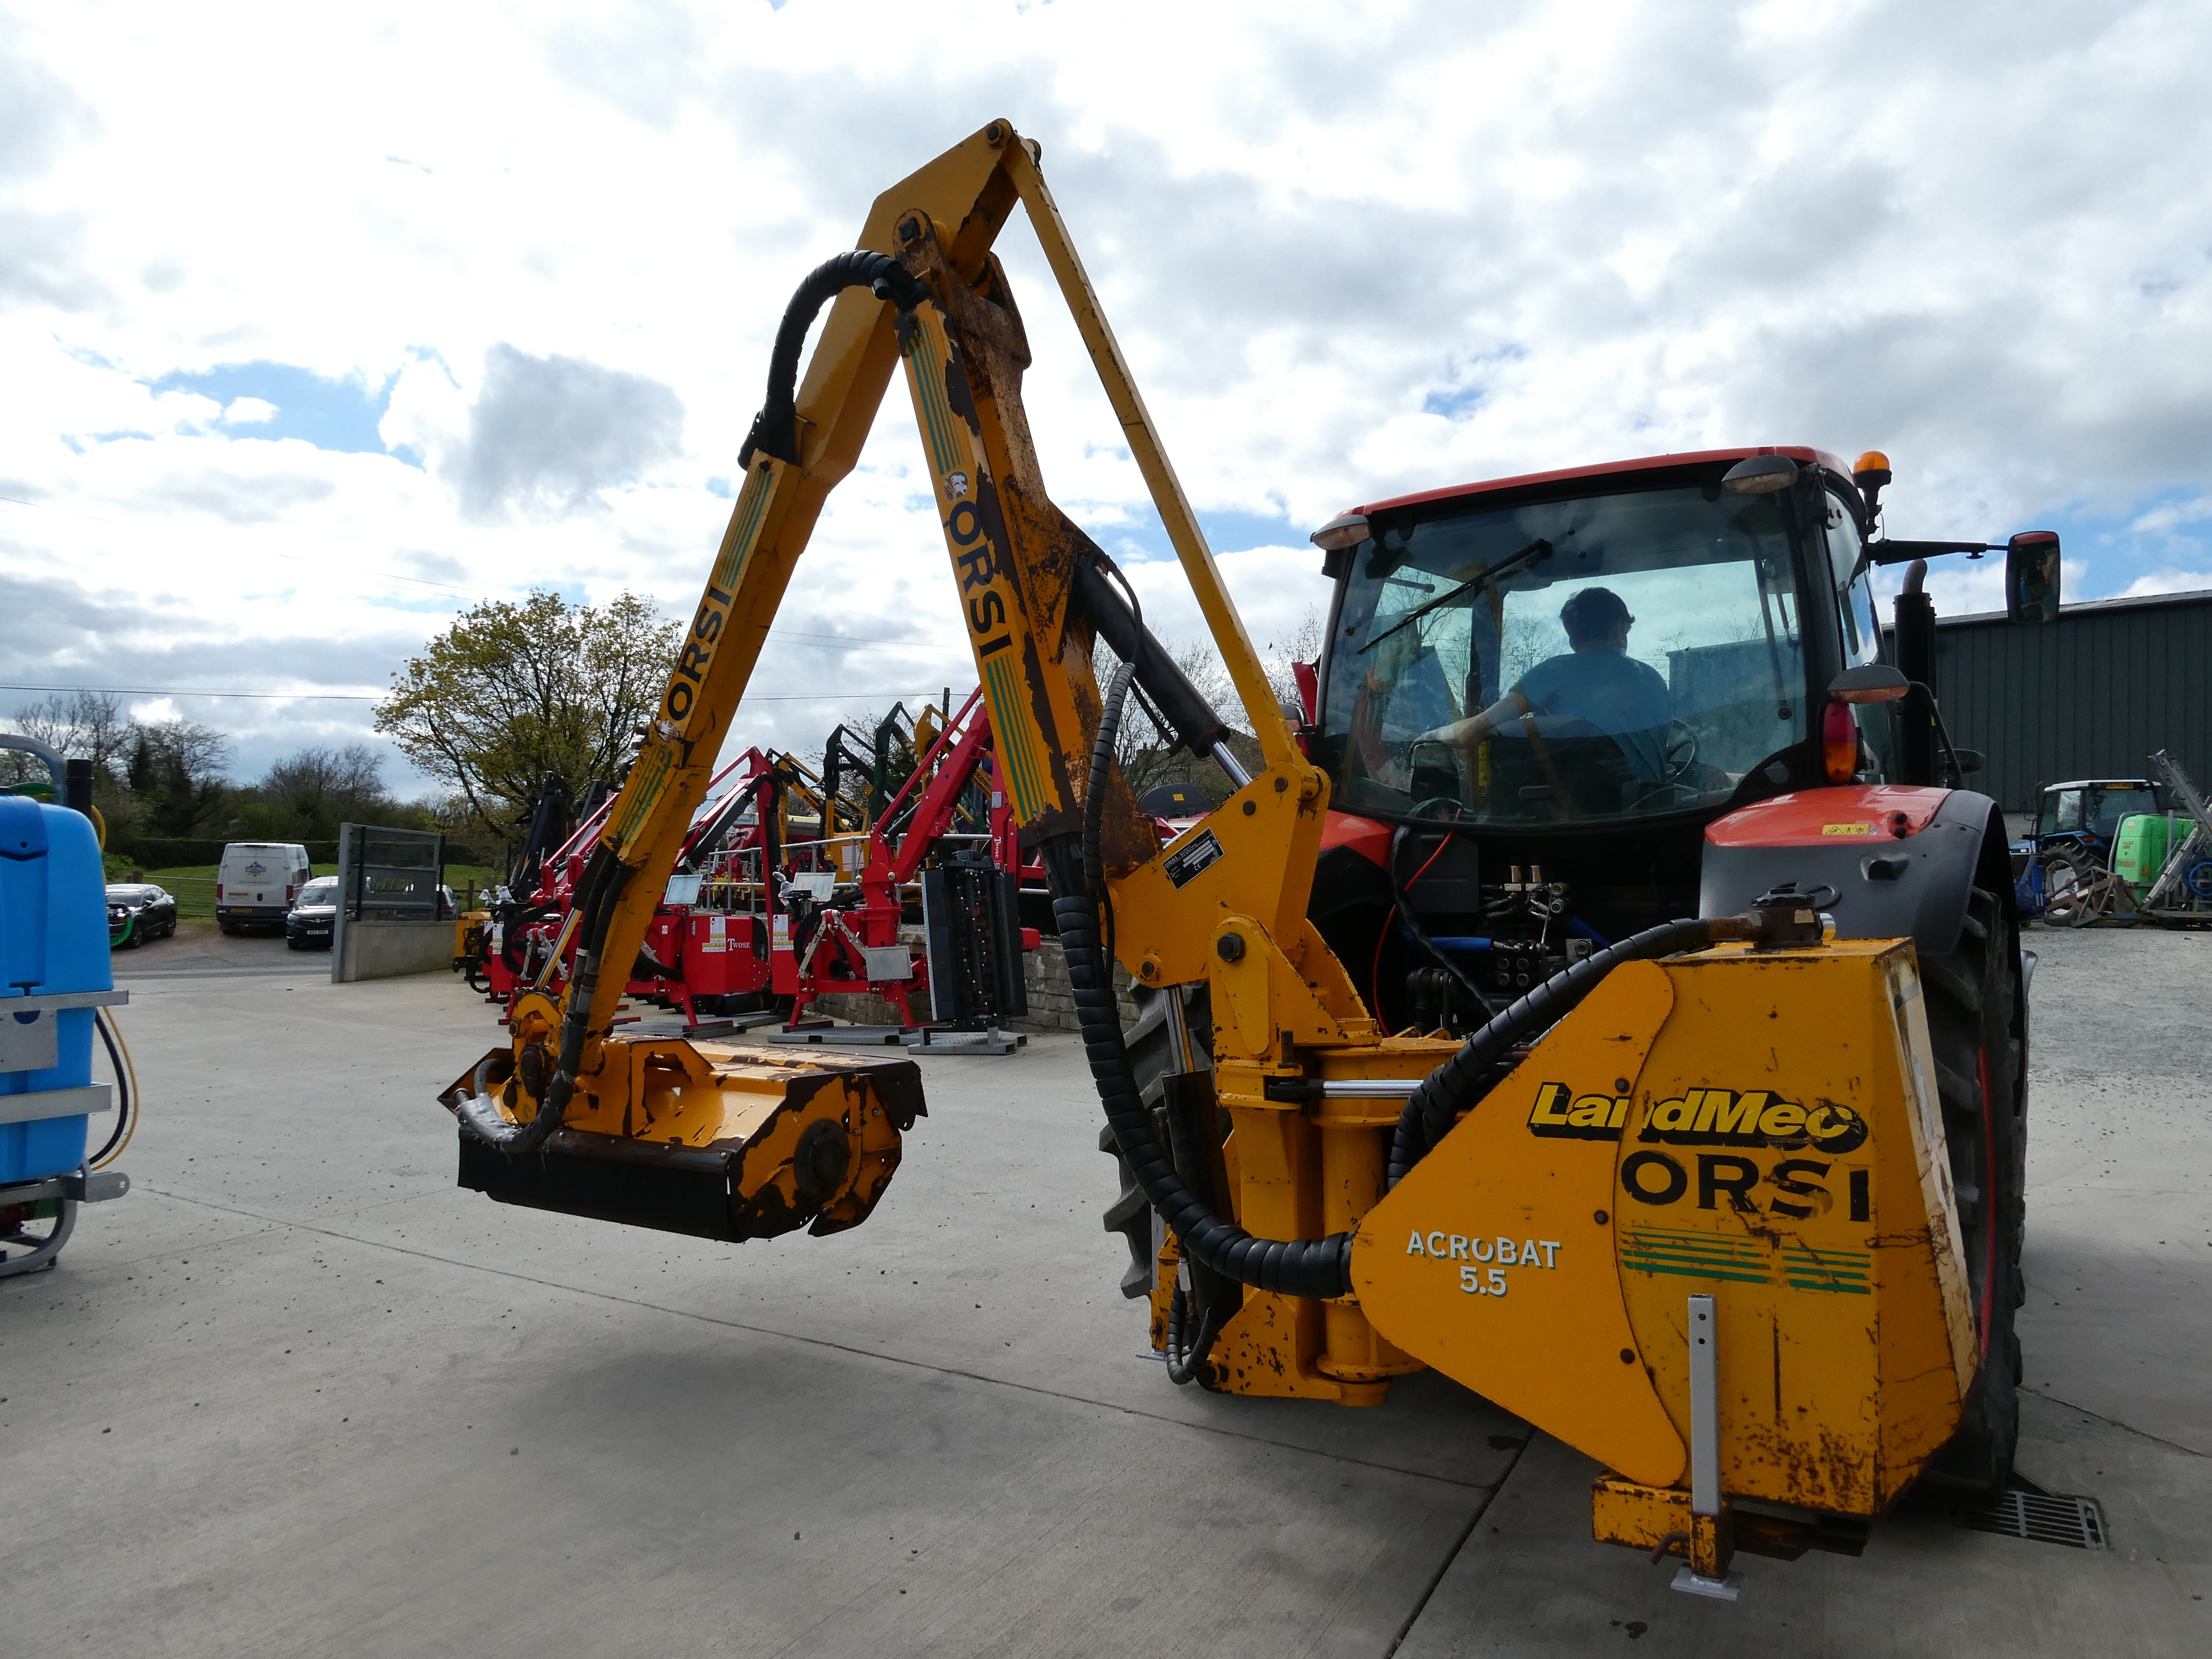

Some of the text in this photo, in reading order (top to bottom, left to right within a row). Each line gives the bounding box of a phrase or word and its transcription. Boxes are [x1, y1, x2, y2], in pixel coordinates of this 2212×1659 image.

[949, 500, 1013, 660] ORSI
[667, 585, 732, 721] ORSI
[1164, 856, 1178, 868] ORSI
[727, 938, 751, 951] TWOSE
[1621, 1150, 1870, 1222] ORSI
[1406, 1229, 1562, 1270] ACROBAT
[1459, 1265, 1508, 1298] 5.5
